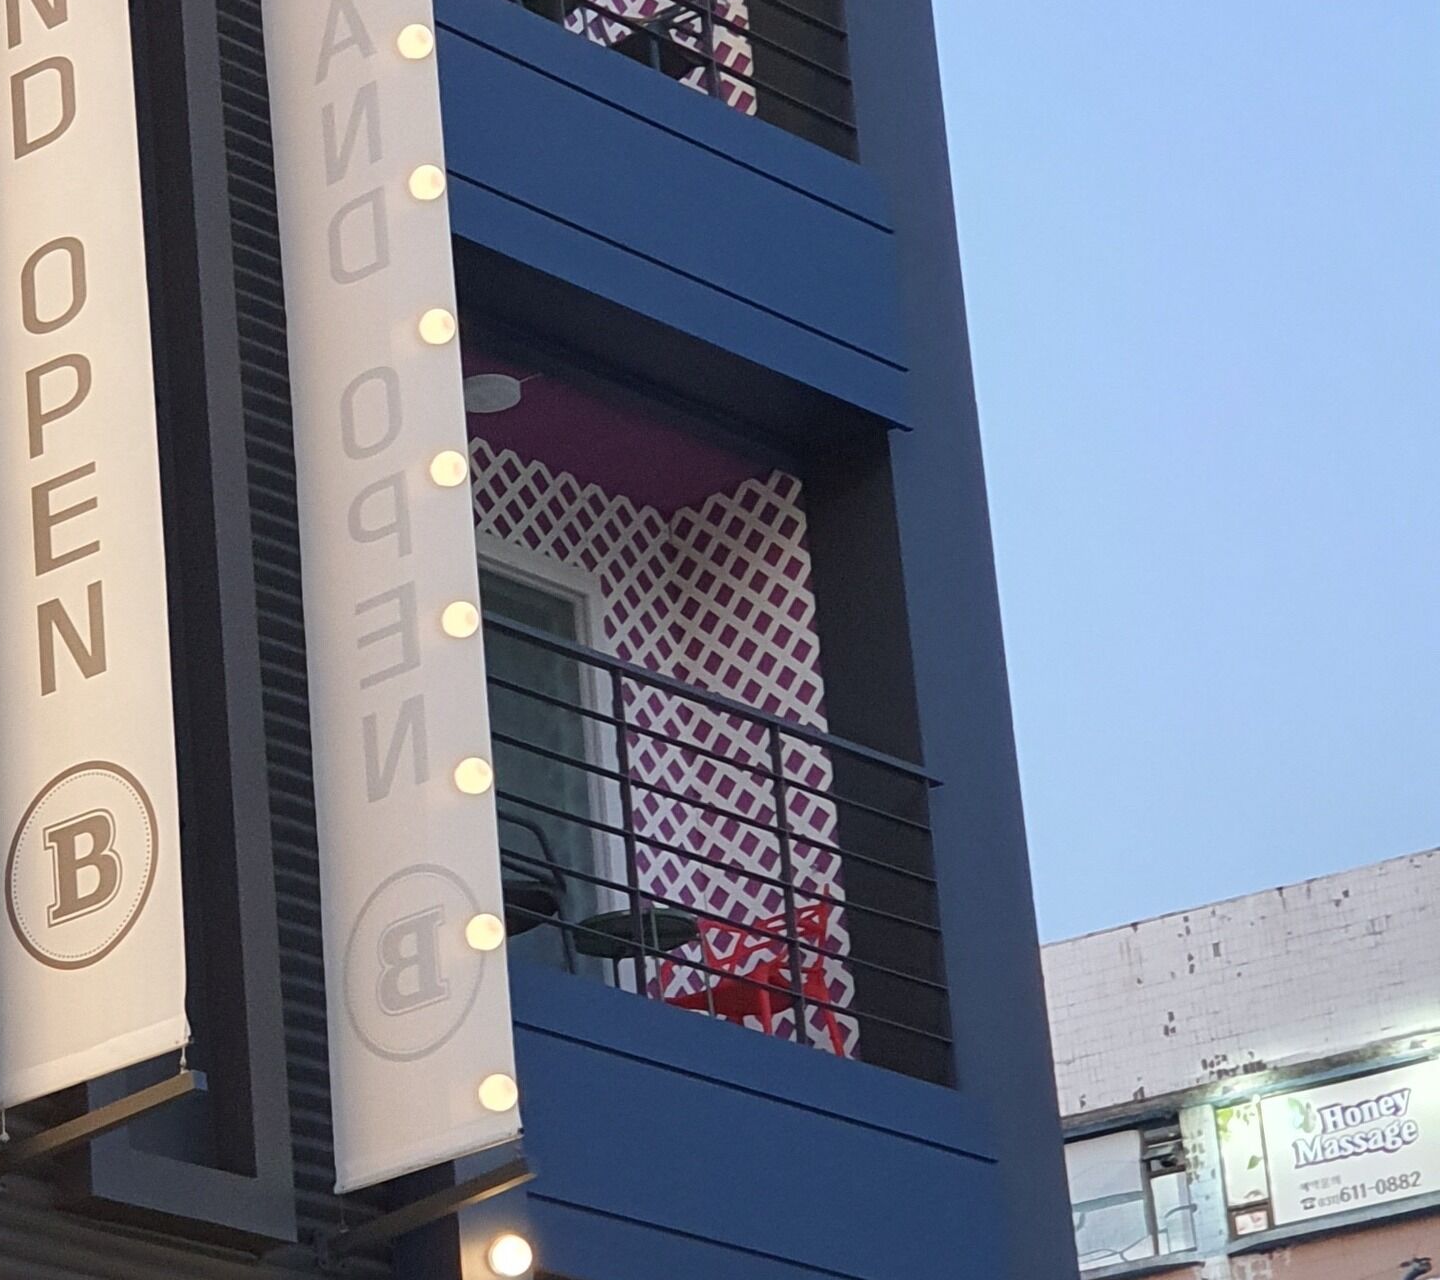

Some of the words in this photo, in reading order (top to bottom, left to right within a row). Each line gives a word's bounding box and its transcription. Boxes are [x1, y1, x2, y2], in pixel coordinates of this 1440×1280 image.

[19, 235, 108, 697] OPEN
[42, 808, 123, 929] B
[1292, 1119, 1419, 1169] Massage
[1317, 1088, 1411, 1135] Honey
